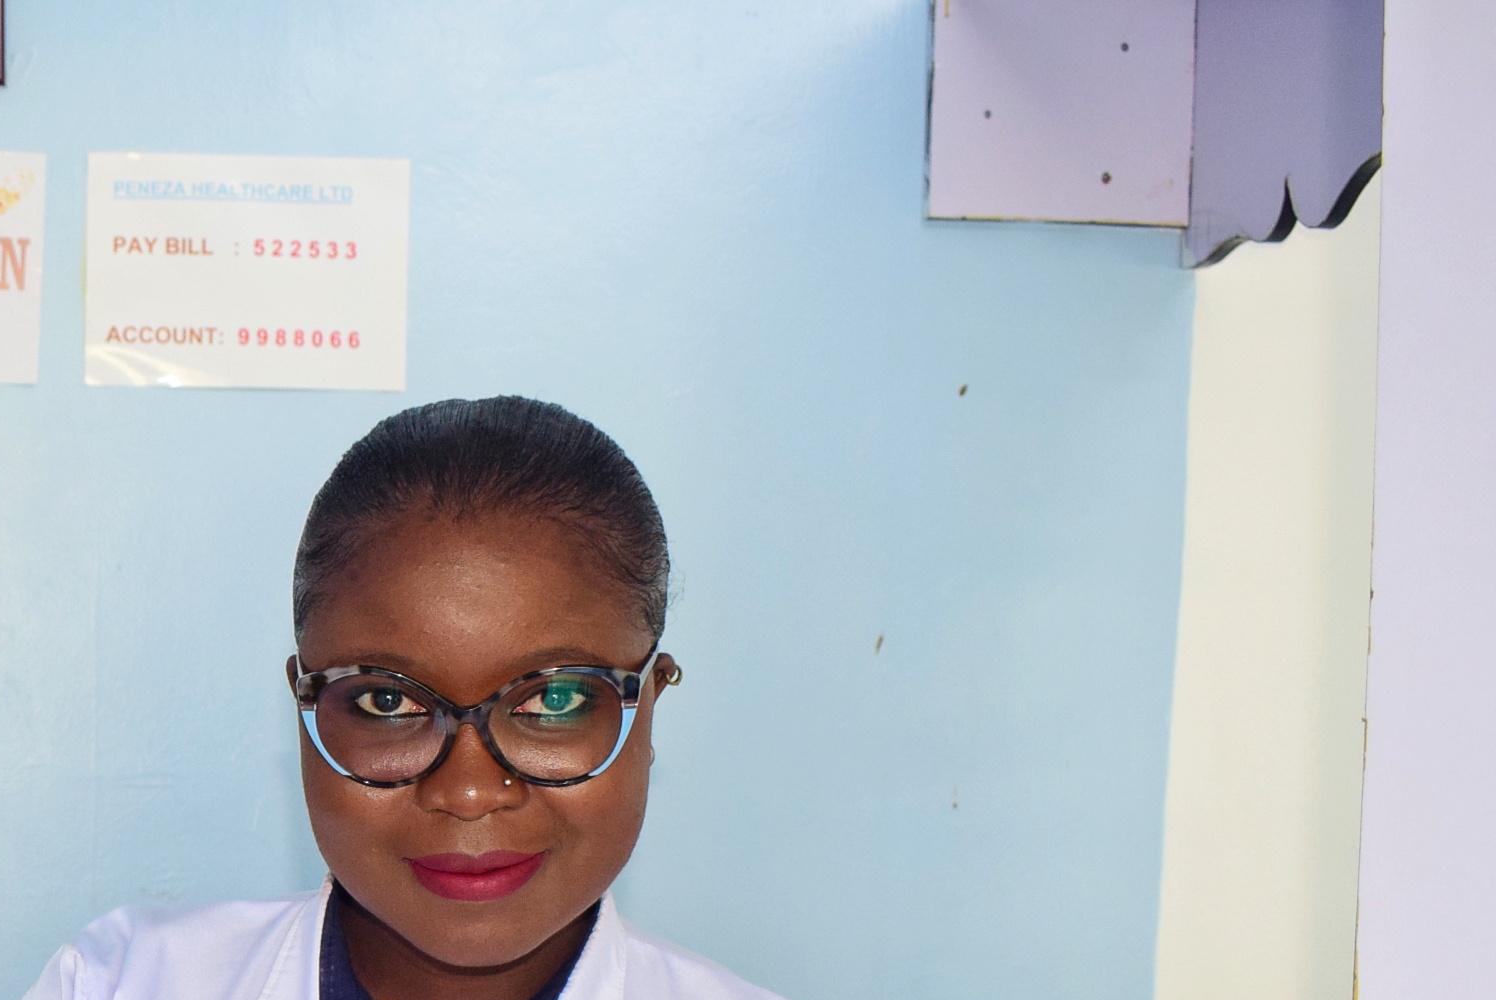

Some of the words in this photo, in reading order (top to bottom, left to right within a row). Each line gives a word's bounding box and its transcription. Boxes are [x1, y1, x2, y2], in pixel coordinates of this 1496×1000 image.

[113, 180, 185, 198] PENEZA
[191, 181, 313, 201] HEALTHCARE
[319, 185, 354, 203] LTD
[112, 236, 158, 255] PAY
[165, 238, 213, 256] BILL
